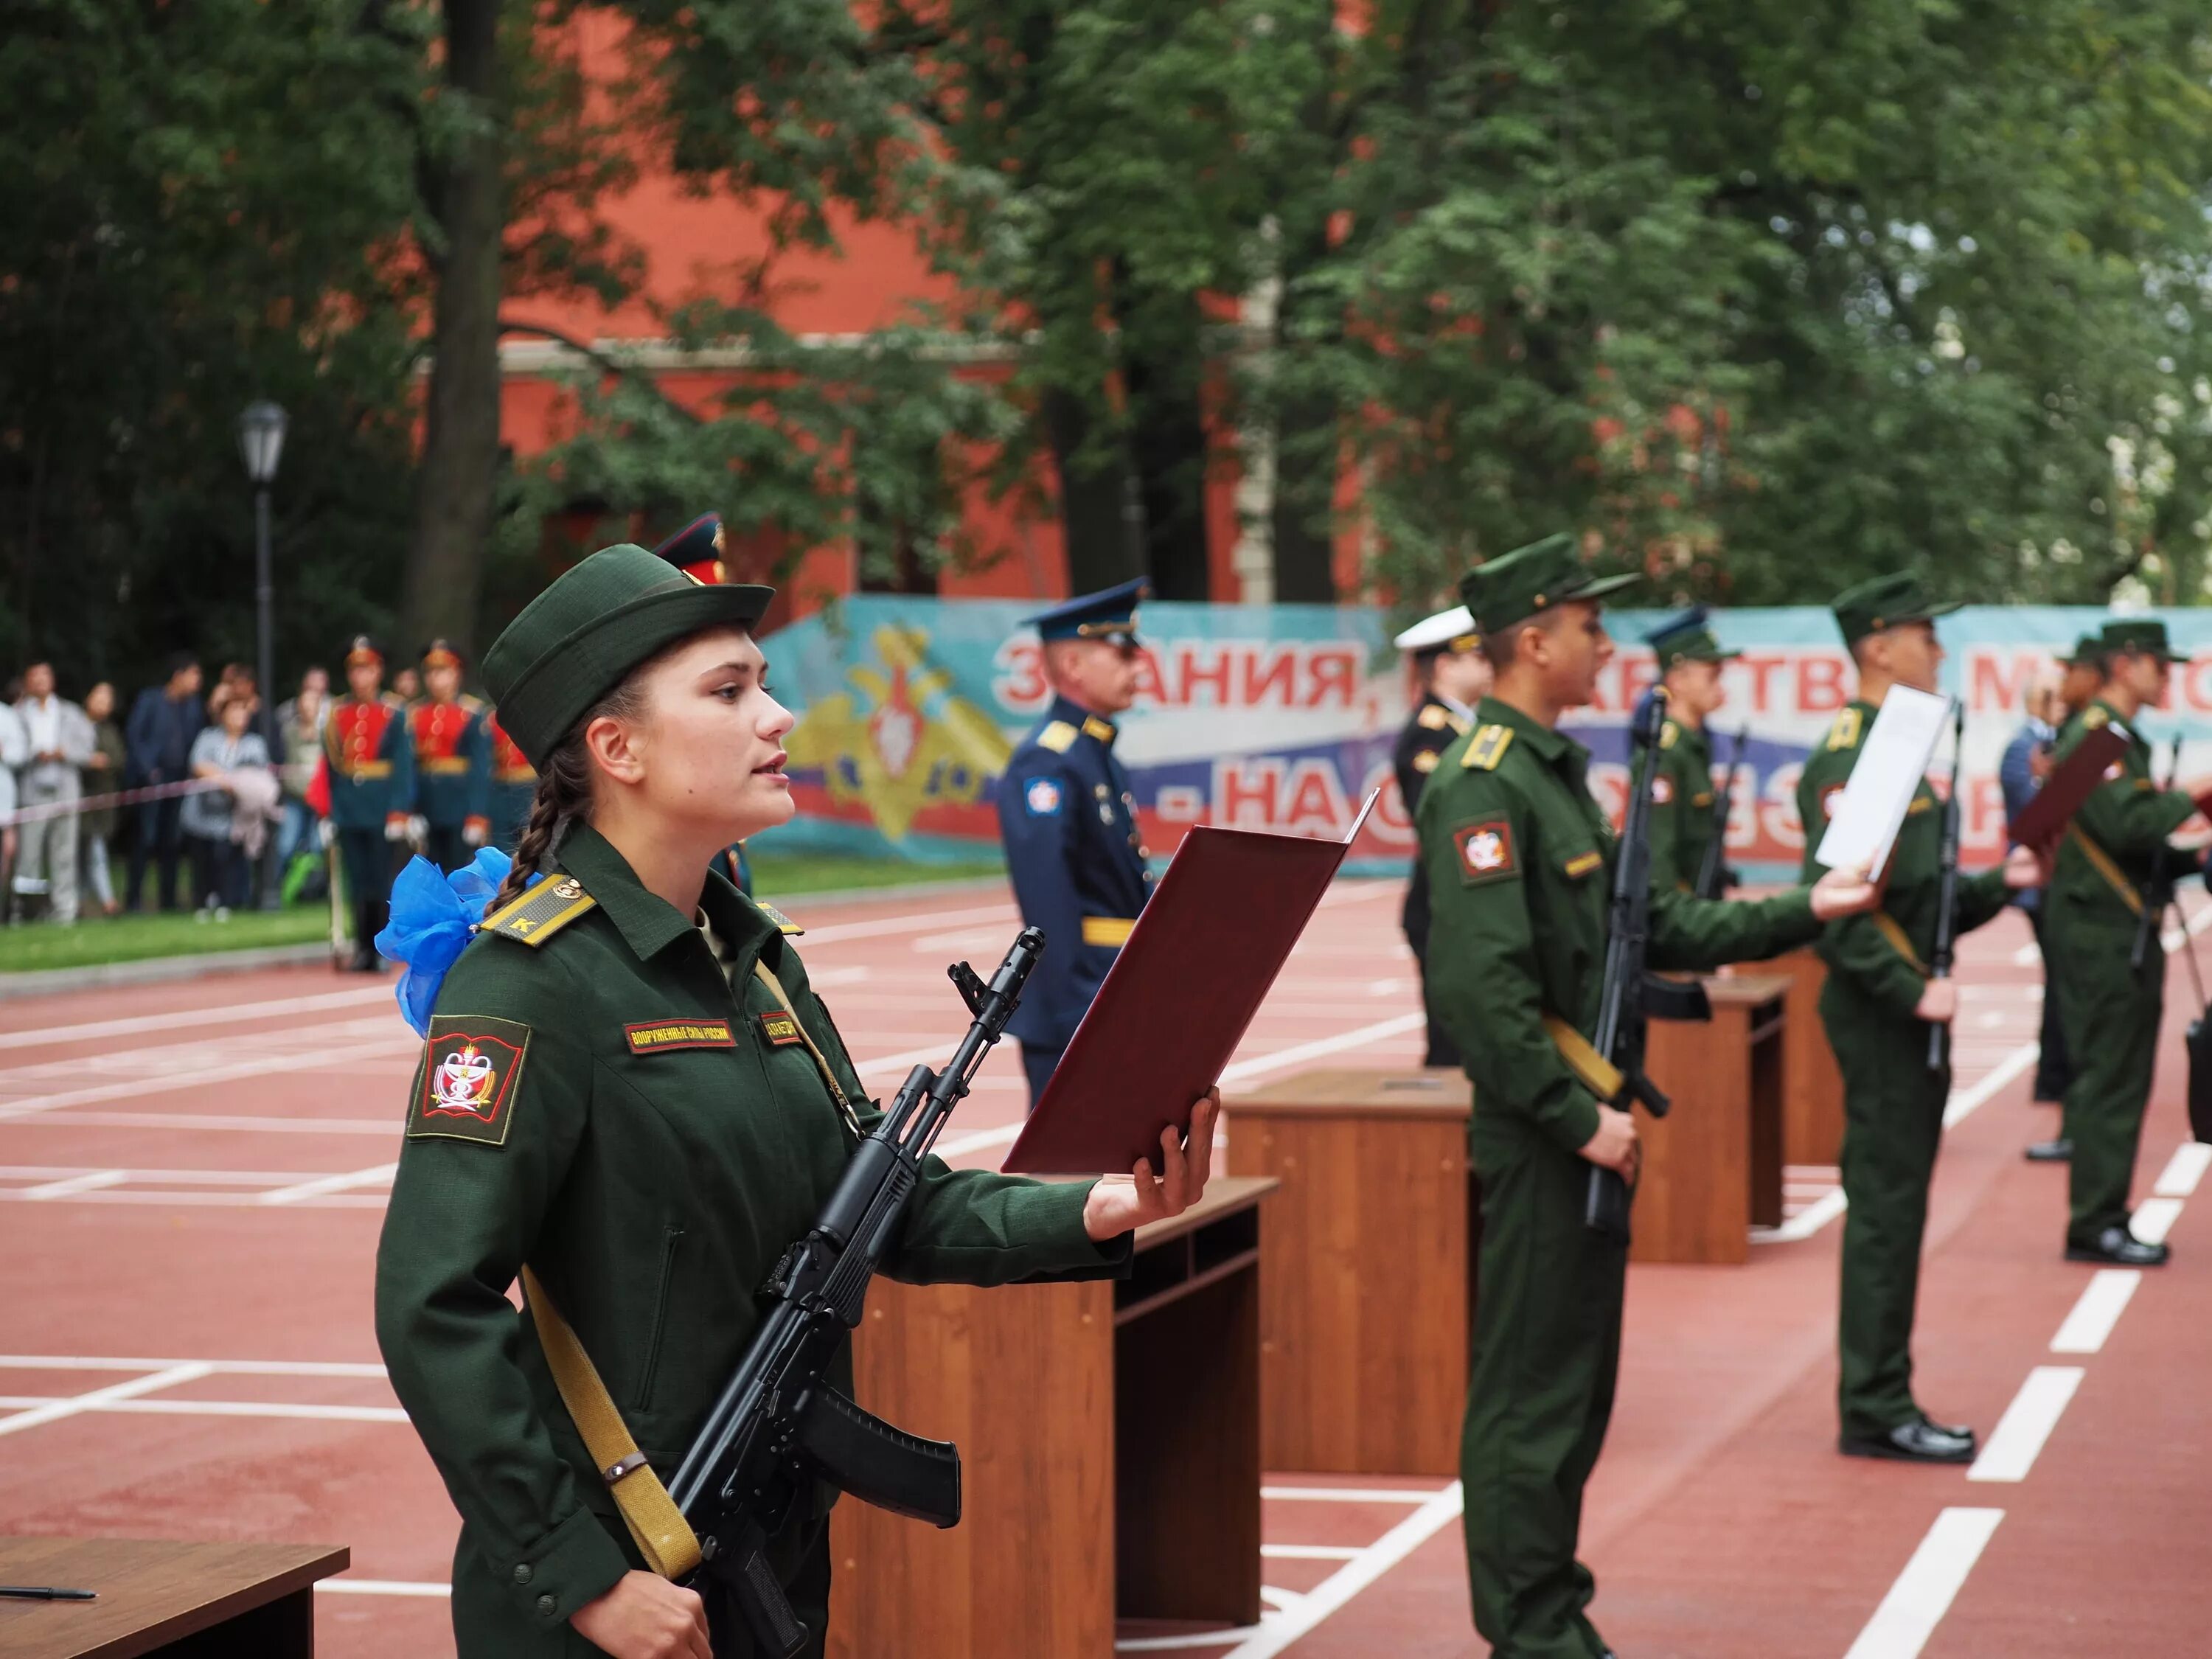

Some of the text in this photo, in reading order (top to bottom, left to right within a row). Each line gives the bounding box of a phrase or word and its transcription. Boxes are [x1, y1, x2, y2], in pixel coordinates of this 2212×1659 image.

[1001, 640, 1379, 731] ЗАНИЯ,
[632, 1026, 689, 1045] ВООРУЖЕННЫЕ
[703, 1027, 729, 1040] РОССИИ
